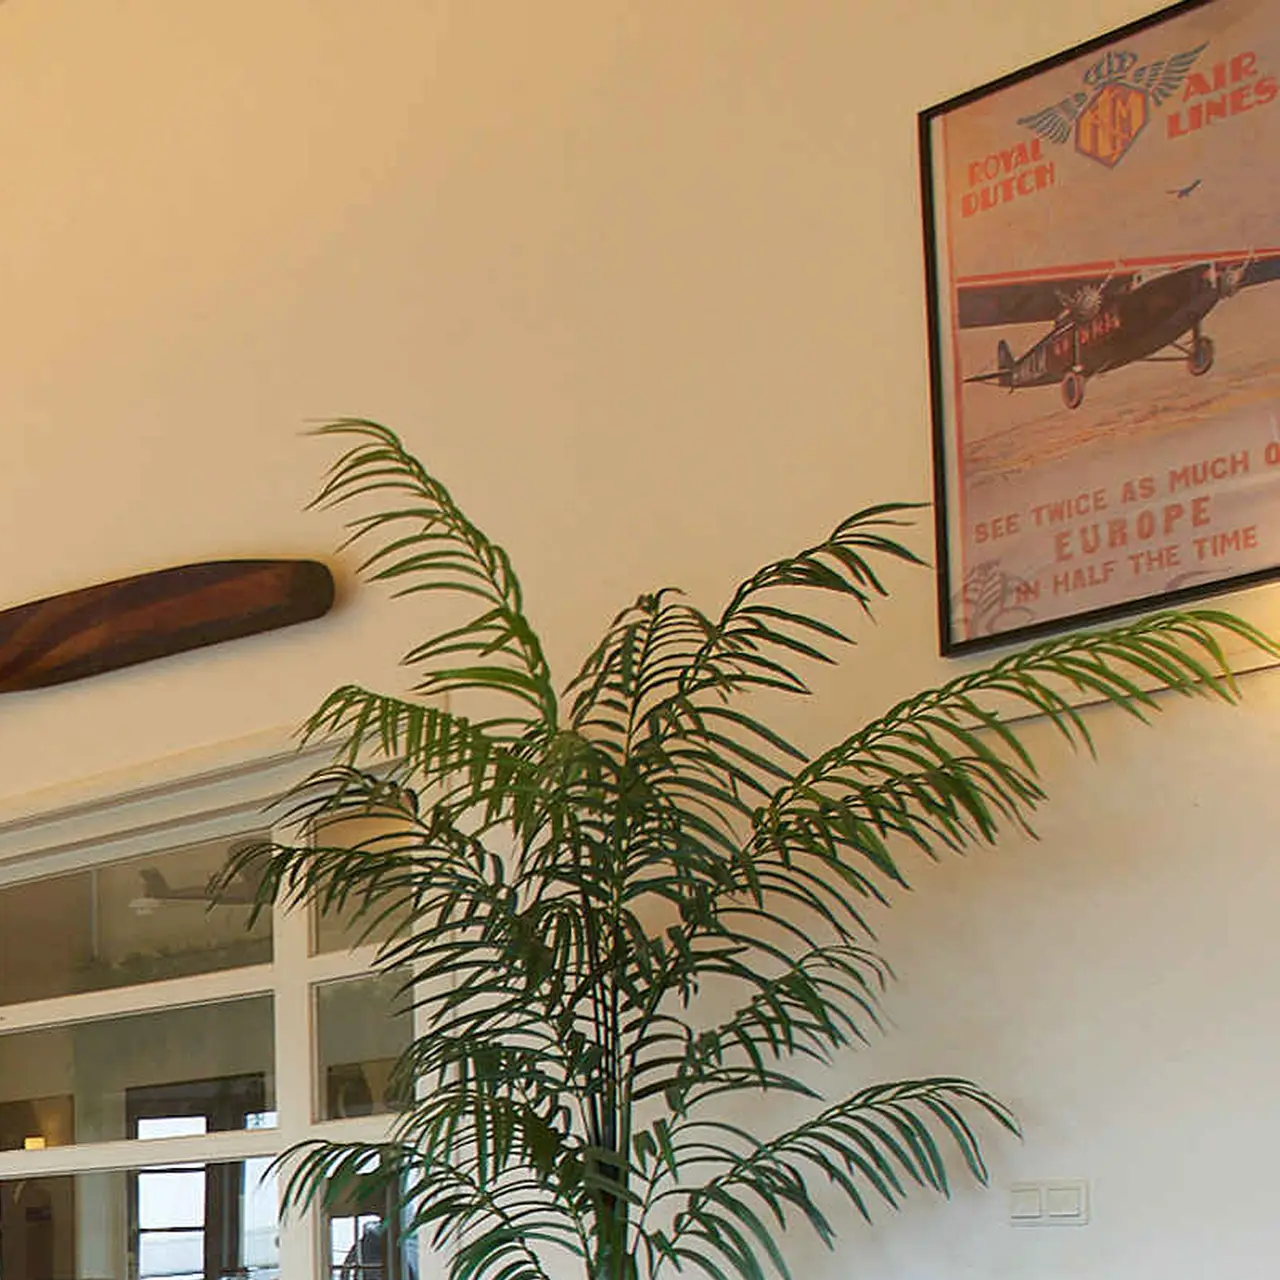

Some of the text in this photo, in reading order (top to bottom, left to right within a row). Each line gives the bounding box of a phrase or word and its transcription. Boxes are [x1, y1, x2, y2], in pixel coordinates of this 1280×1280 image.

[1167, 76, 1279, 139] LINES
[1183, 50, 1258, 103] AIR
[961, 162, 1056, 218] DUTCH
[967, 138, 1045, 185] ROYAL
[974, 513, 1020, 544] SEE
[1031, 488, 1108, 528] TWICE
[1122, 476, 1156, 505] AS
[1169, 449, 1250, 493] MUCH
[1053, 495, 1211, 563] EUROPE
[1053, 560, 1116, 595] HALF
[1129, 545, 1180, 574] THE
[1193, 525, 1261, 563] TIME
